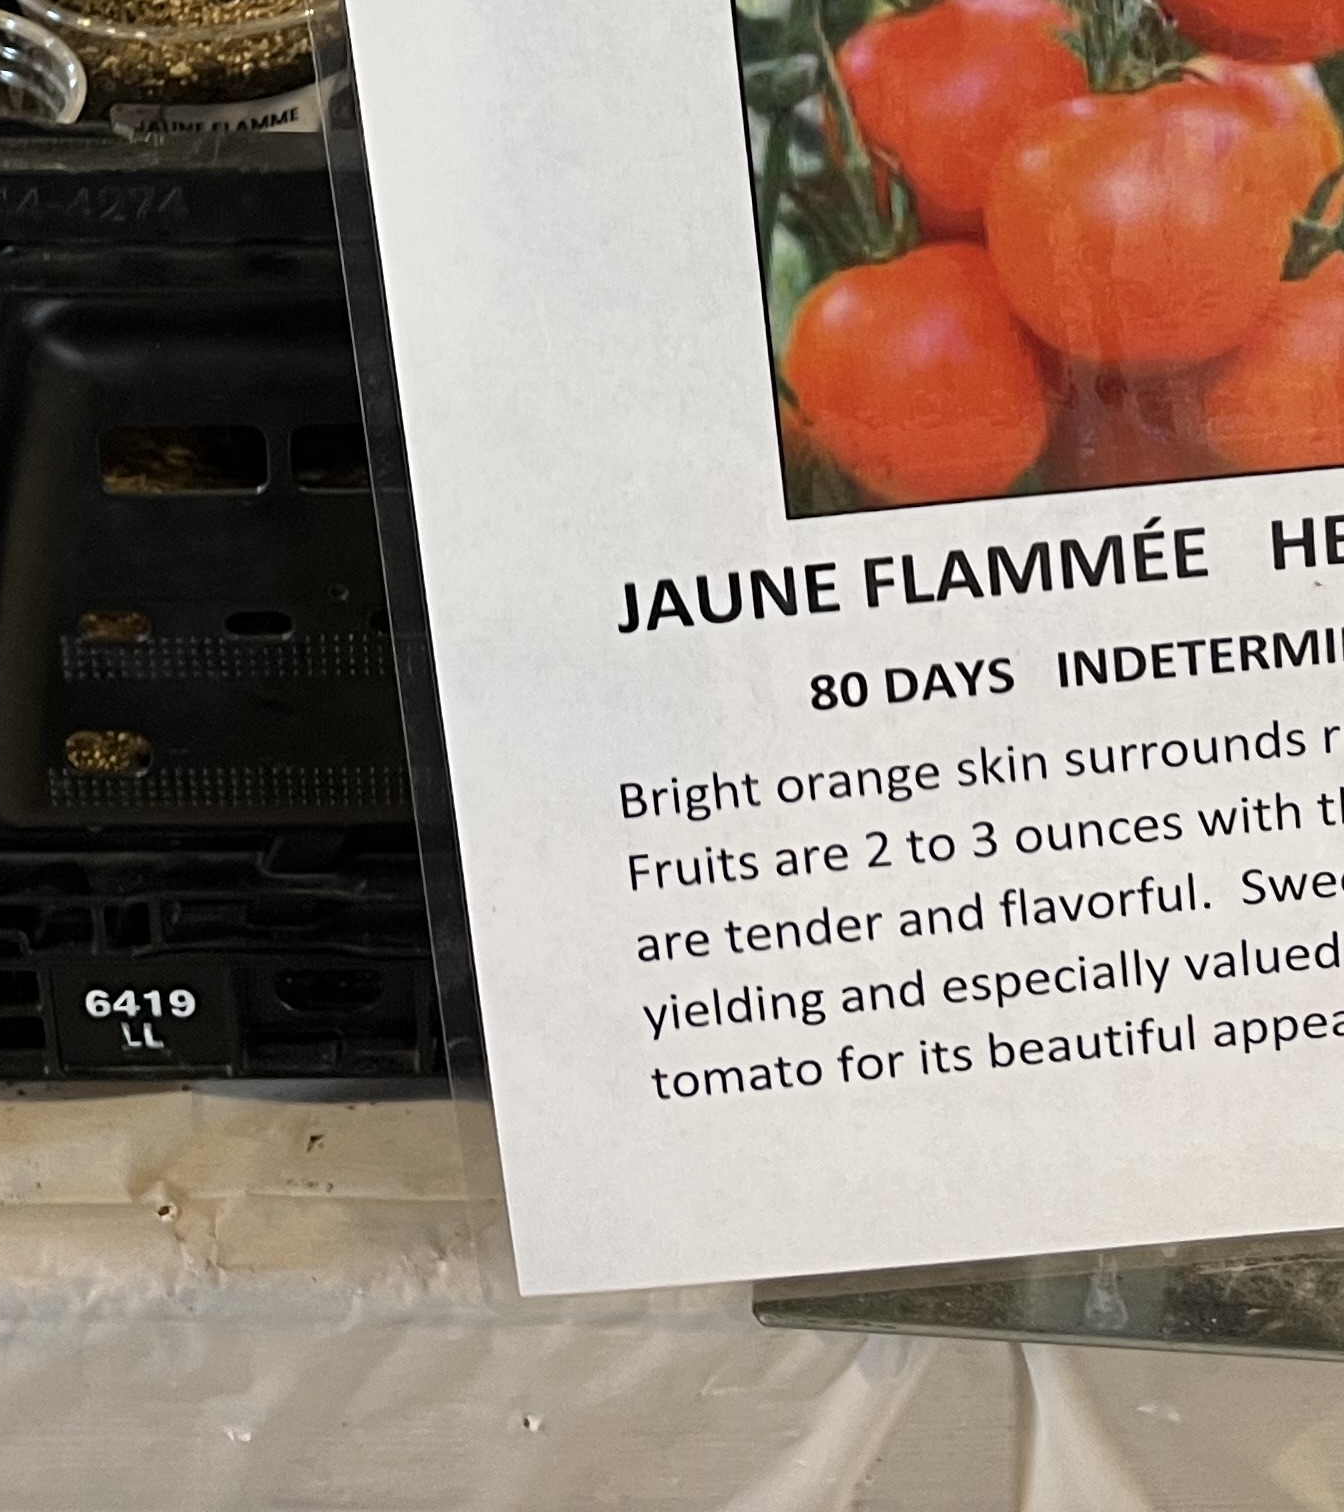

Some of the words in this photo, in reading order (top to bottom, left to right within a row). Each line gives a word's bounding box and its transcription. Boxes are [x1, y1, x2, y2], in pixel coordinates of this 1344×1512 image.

[617, 561, 841, 634] JAUNE
[862, 515, 1209, 608] FLAMMÉE
[809, 670, 868, 711] 80
[883, 656, 1015, 704] DAYS
[618, 770, 761, 822] Bright
[776, 761, 940, 803] orange
[956, 744, 1048, 787] skin
[1064, 718, 1306, 777] surrounds
[627, 845, 759, 891] Fruits
[774, 843, 848, 877] are
[864, 830, 892, 868] 2
[904, 829, 955, 864] to
[971, 820, 998, 858] 3
[1014, 811, 1183, 854] ounces
[1196, 791, 1301, 837] with
[636, 929, 710, 962] are
[723, 905, 883, 954] tender
[898, 890, 984, 937] and
[998, 871, 1211, 928] flavorful.
[85, 988, 197, 1019] 6419
[642, 984, 826, 1041] yielding
[841, 968, 925, 1013] and
[942, 948, 1170, 1008] especially
[1183, 929, 1340, 981] valued
[650, 1055, 823, 1100] tomato
[836, 1043, 904, 1083] for
[918, 1039, 973, 1075] its
[987, 1012, 1195, 1068] beautiful
